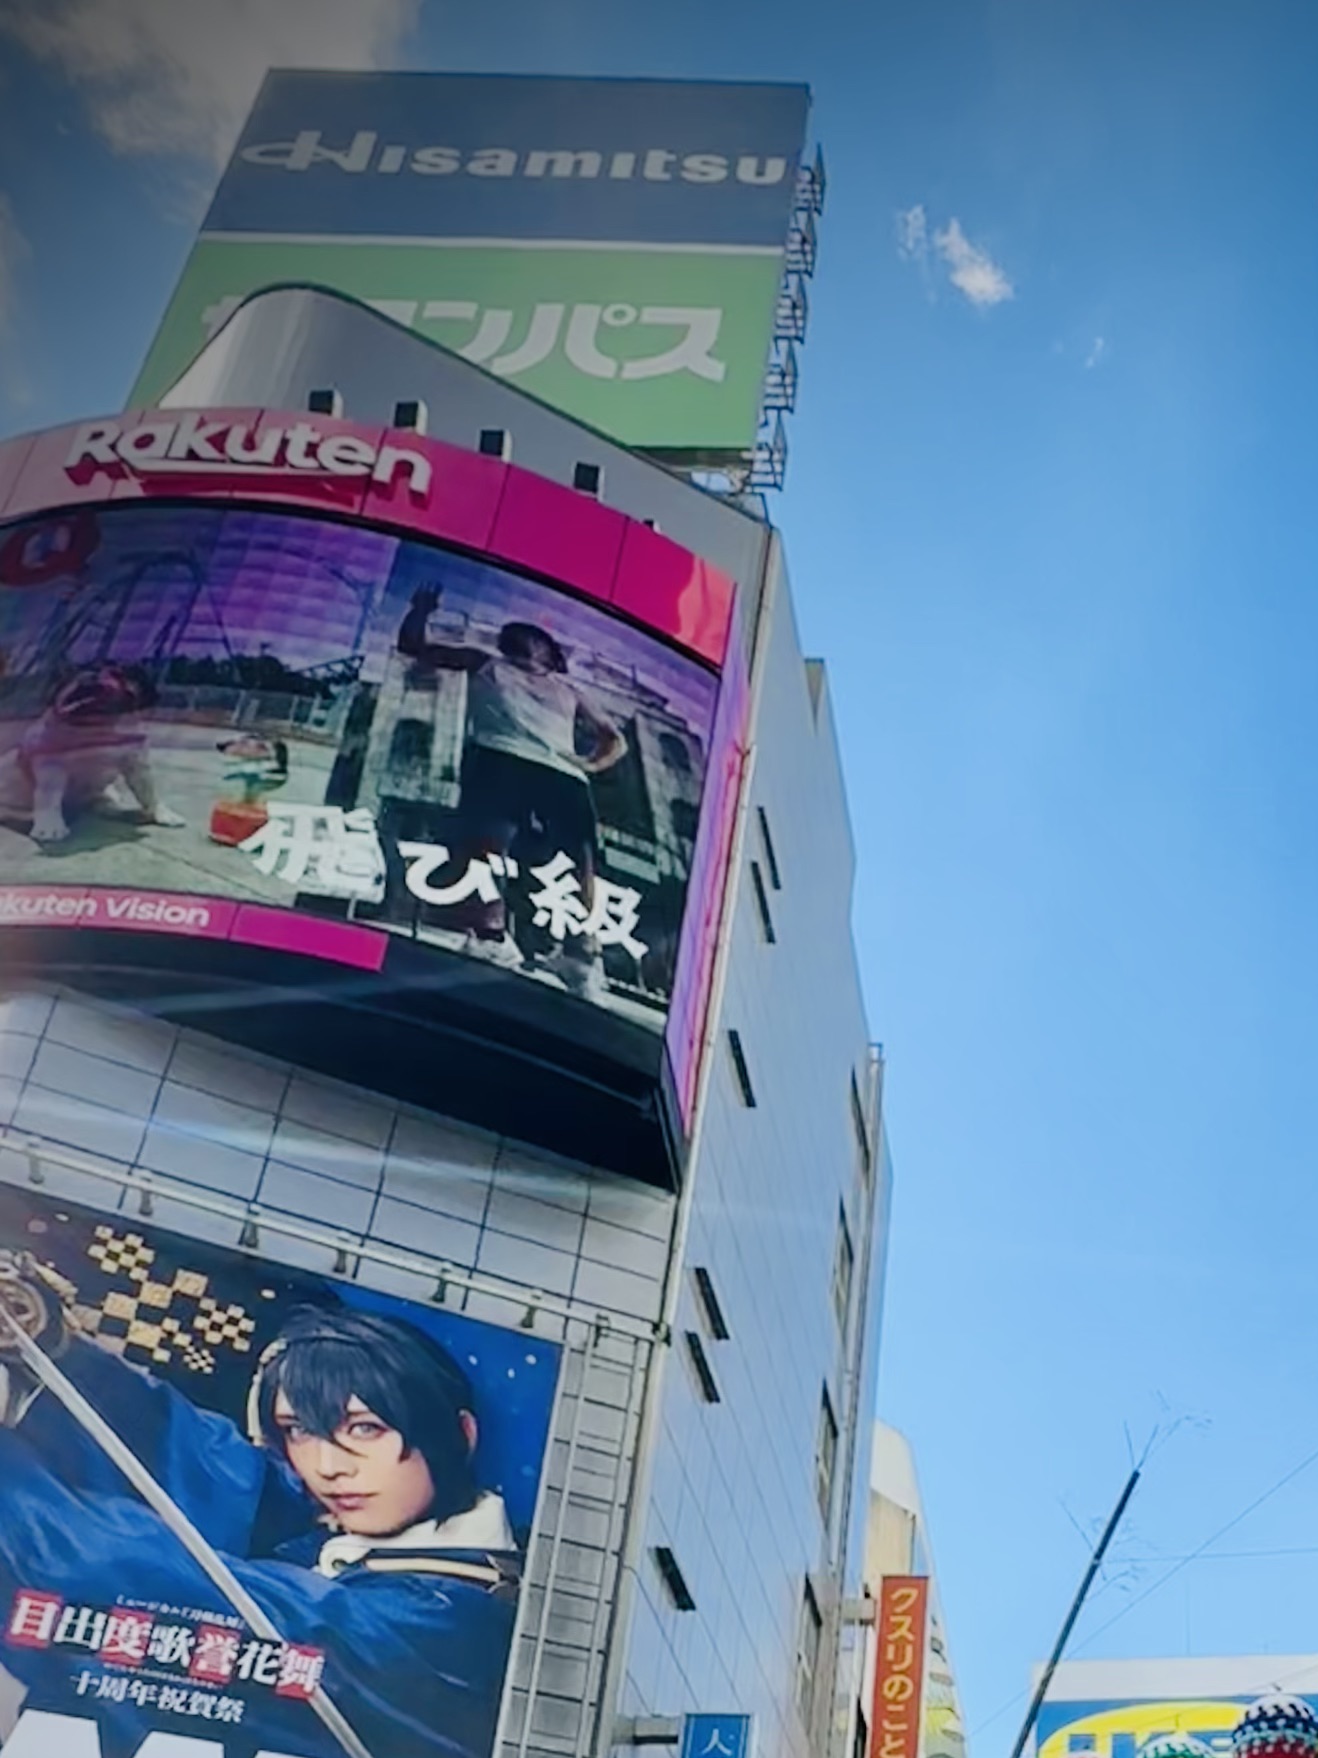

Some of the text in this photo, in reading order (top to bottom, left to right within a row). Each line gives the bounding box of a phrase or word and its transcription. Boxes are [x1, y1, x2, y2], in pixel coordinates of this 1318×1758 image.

[240, 130, 788, 187] Hisamitsu
[62, 417, 432, 498] Rakuten
[0, 893, 211, 928] kuten Vision
[237, 803, 648, 959] 飛び級
[10, 1596, 326, 1694] 目出度歌誉花舞
[70, 1670, 246, 1724] 十周年祝賀祭
